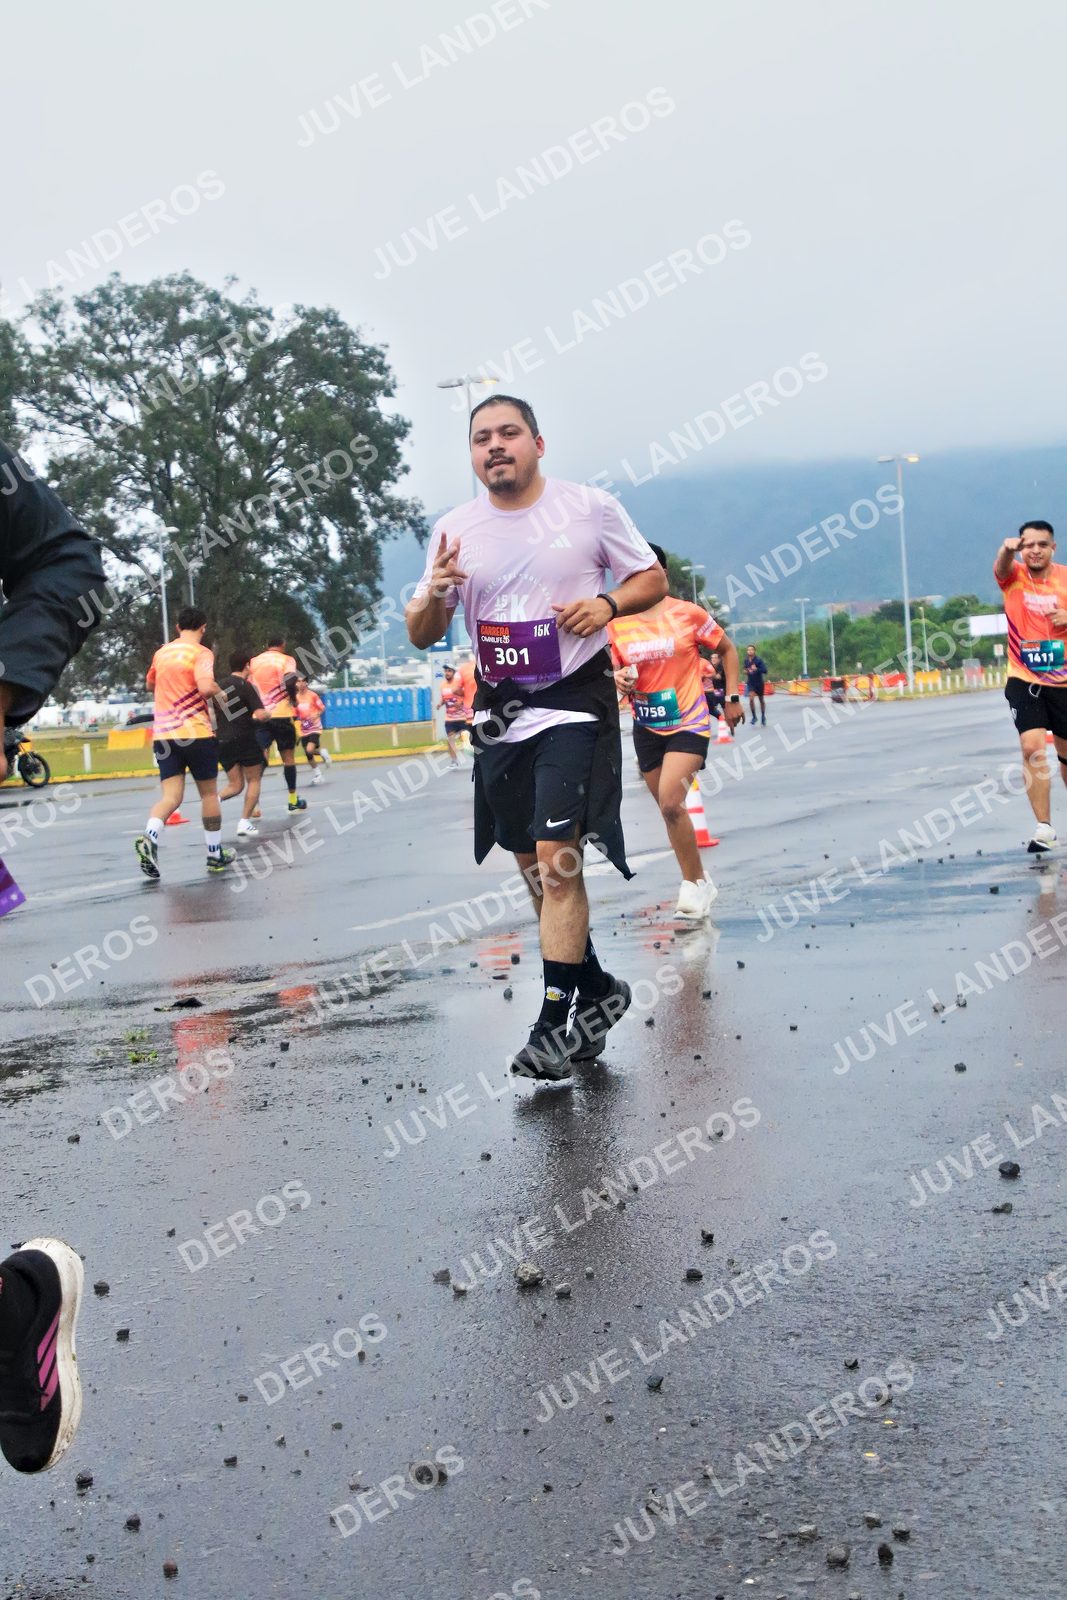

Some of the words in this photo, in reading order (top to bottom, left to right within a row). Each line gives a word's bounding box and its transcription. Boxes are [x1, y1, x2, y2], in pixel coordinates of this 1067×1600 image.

[480, 625, 510, 636] CARRERA
[494, 647, 530, 666] 301
[1027, 652, 1055, 663] 1411
[638, 705, 667, 718] 1758
